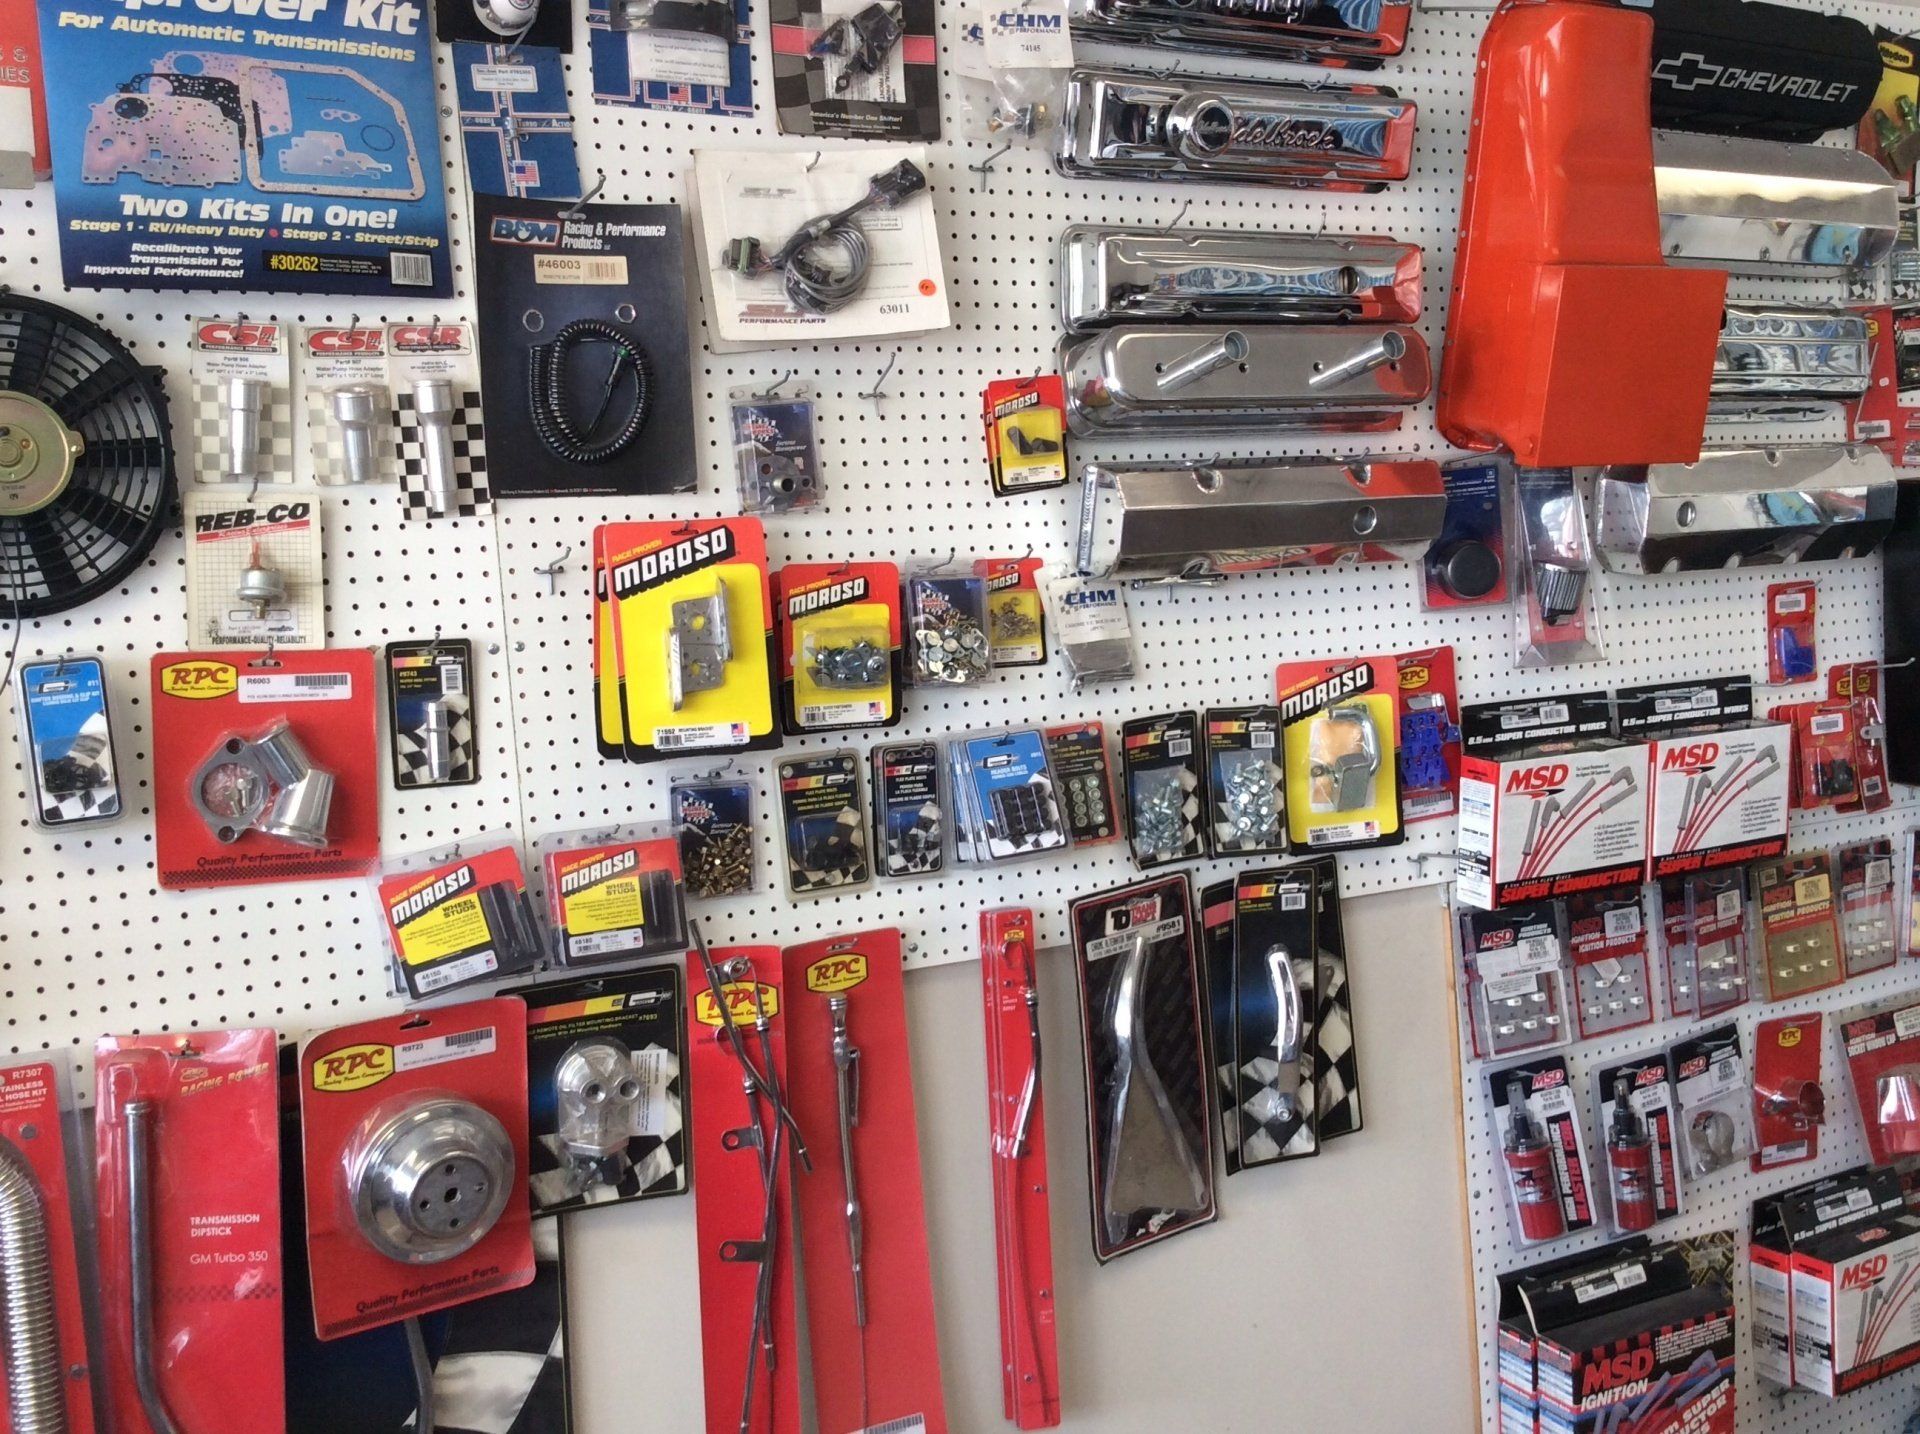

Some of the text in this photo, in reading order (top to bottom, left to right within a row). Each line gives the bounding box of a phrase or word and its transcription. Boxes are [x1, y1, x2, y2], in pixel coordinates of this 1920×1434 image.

[343, 0, 421, 35] Kit
[999, 13, 1062, 28] CHM
[58, 11, 416, 62] For Automatic Transmissions
[1015, 26, 1062, 34] PERFORMANCE
[1719, 67, 1858, 103] CHEVROLET
[840, 112, 865, 120] Number
[120, 194, 398, 230] Two Kits In One!
[70, 219, 440, 248] Stage 1 RV/Heavy Duty Stage 2 Street/Strip
[493, 218, 557, 243] B&M
[563, 220, 667, 237] Racing & Performance
[131, 242, 243, 256] Recalibrate Your
[561, 235, 603, 250] Products
[130, 254, 243, 268] Transmission For
[269, 254, 319, 272] #30262
[537, 258, 581, 270] #46003
[83, 265, 244, 279] Improved Performance!
[879, 303, 910, 315] 63011
[393, 326, 462, 346] CSR
[994, 391, 1038, 418] MOROSO
[196, 502, 310, 533] REB-CO
[612, 539, 662, 563] RACE PROVEN
[614, 528, 728, 593] MOROSO
[806, 578, 831, 590] PROVEN
[789, 578, 865, 615] MOROSO
[1065, 589, 1116, 606] CHM
[1079, 601, 1117, 609] PERFORMANCE
[170, 667, 229, 685] RPC
[246, 677, 271, 685] R6003
[1400, 669, 1426, 684] RPC
[1281, 664, 1369, 721] MOROSO
[1622, 704, 1749, 728] 8.5mm SUPER CONDUCTOR WIRES
[1467, 721, 1608, 746] 8.5mm SUPER CONDUCTOR WIRES
[1662, 742, 1720, 771] MSD
[1505, 764, 1569, 794] MSD
[196, 847, 344, 868] Quality Performance Parts
[1658, 841, 1784, 876] SUPER CONDUCTOR
[561, 850, 636, 893] MOROSO
[605, 881, 634, 889] WHEEL
[606, 886, 636, 896] STUDS
[1501, 867, 1641, 902] SUPER CONDUCTOR
[390, 865, 471, 926] MOROSO
[441, 899, 476, 912] WHEEL
[443, 905, 477, 919] STUDS
[1156, 918, 1181, 933] #9581
[1480, 928, 1514, 948] MSD
[1605, 934, 1637, 948] PRODUCTS
[814, 957, 860, 982] RPC
[536, 1025, 559, 1035] REMOTE
[568, 1021, 586, 1030] FILTER
[586, 1017, 615, 1027] MOUNTING
[614, 1013, 638, 1022] BRACKET
[12, 1067, 43, 1080] R7307
[323, 1048, 385, 1079] RPC
[1679, 1056, 1706, 1079] MSD
[0, 1080, 44, 1093] TAINLESS
[180, 1062, 270, 1097] RACING POWER
[1532, 1069, 1565, 1090] MSD
[1634, 1066, 1665, 1086] MSD
[5, 1087, 48, 1101] HOSE KIT
[190, 1214, 260, 1225] TRANSMISSION
[1814, 1219, 1838, 1234] SUPER
[1838, 1205, 1880, 1226] CONDUCTOR
[1880, 1196, 1903, 1210] WIRES
[190, 1226, 232, 1237] DIPSTICK
[190, 1250, 268, 1264] GM Turbo 350
[1839, 1254, 1888, 1291] MSD
[356, 1265, 500, 1314] Quality Performance Parts
[1582, 1348, 1655, 1395] MSD
[1580, 1379, 1649, 1412] IGNITION
[1682, 1377, 1730, 1424] SUPER
